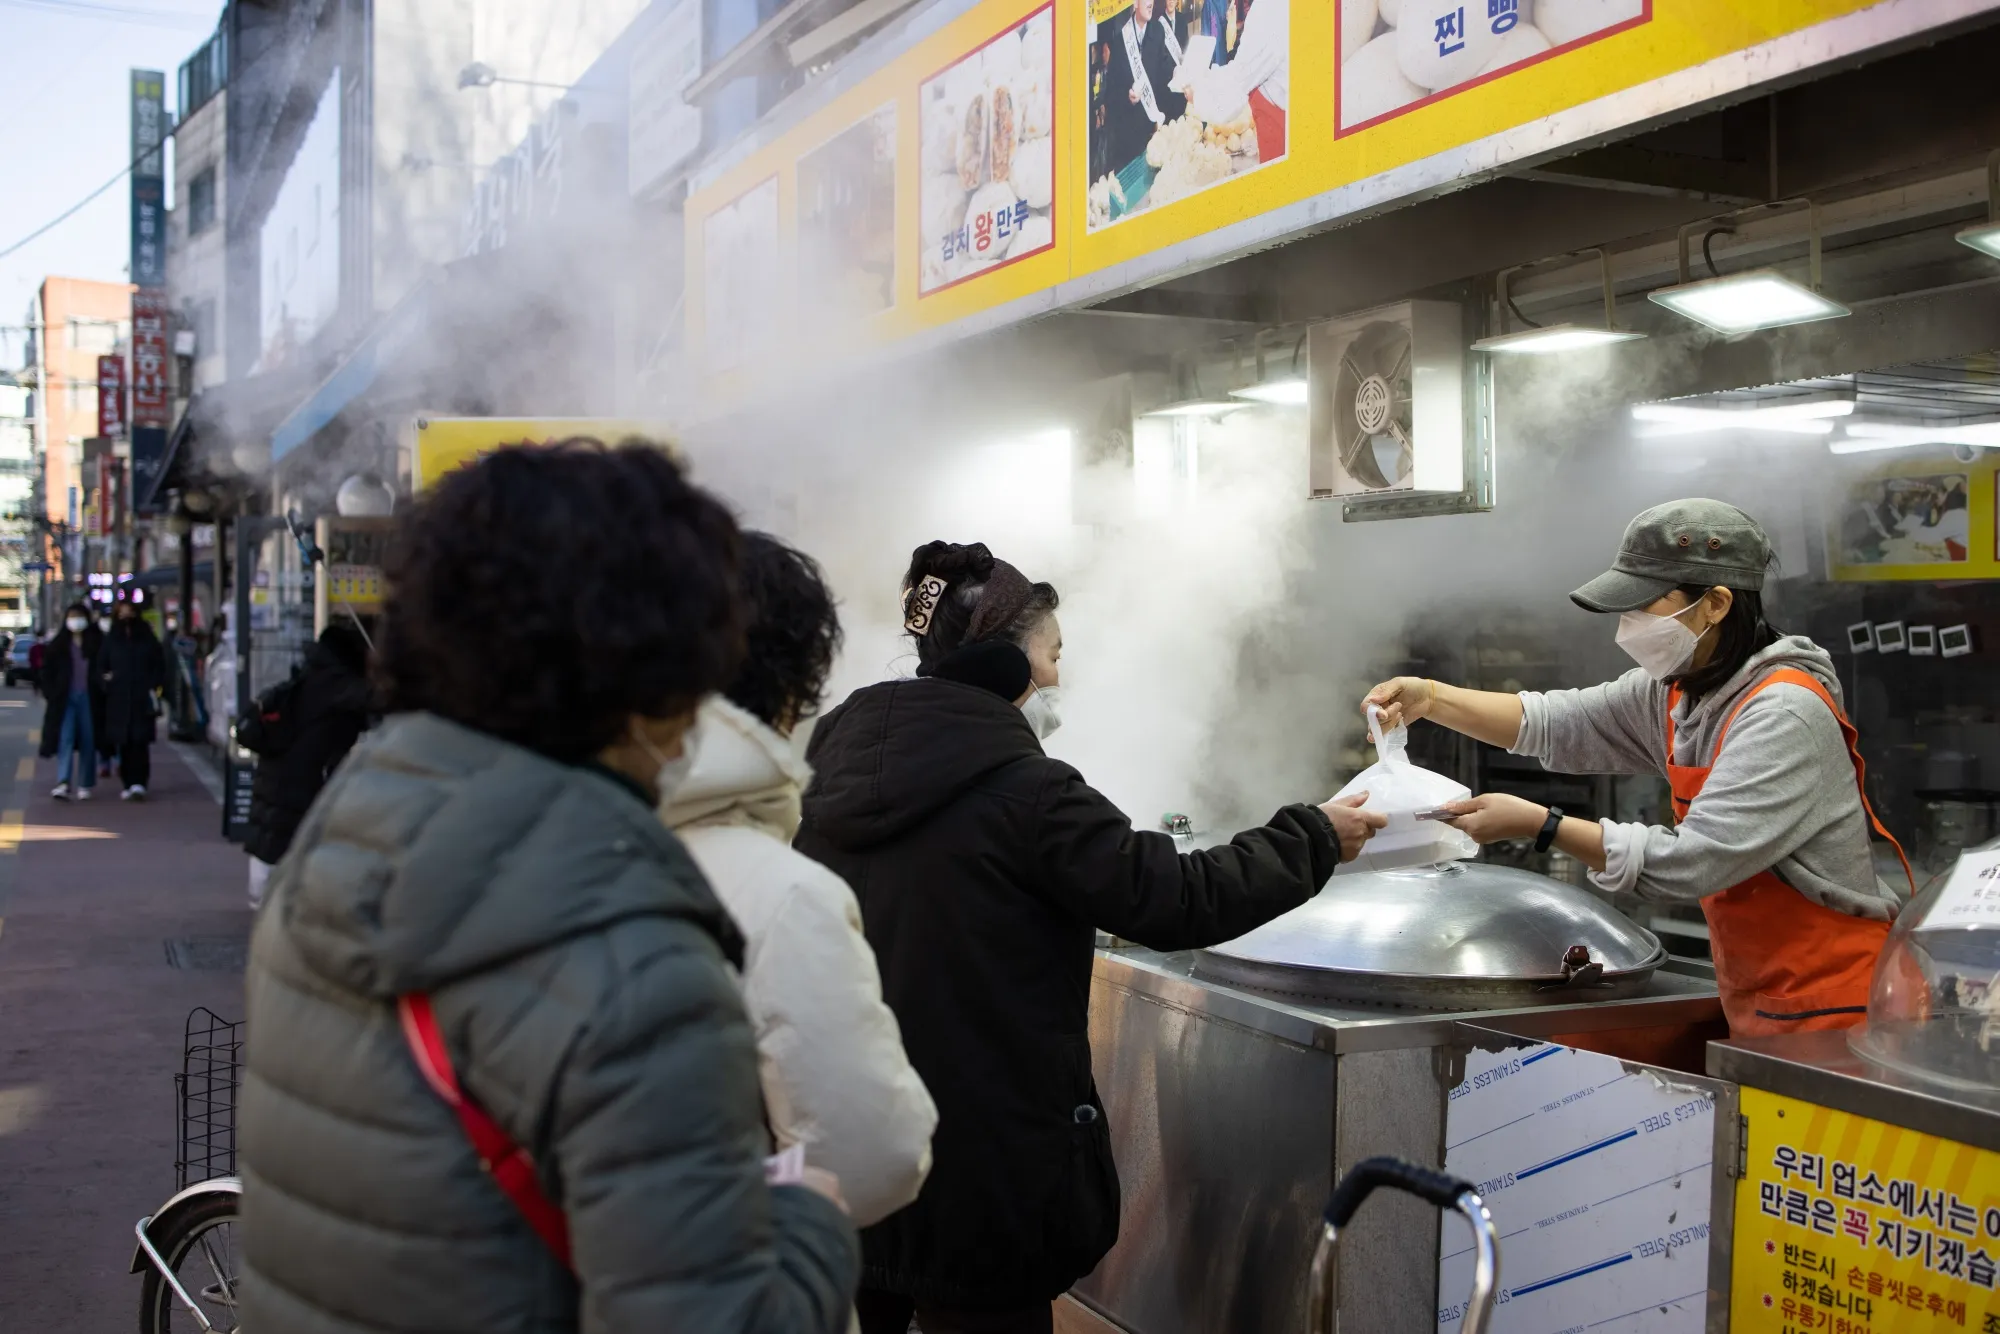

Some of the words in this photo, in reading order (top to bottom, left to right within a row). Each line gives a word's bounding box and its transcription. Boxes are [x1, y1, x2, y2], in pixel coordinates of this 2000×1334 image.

[135, 317, 163, 404] 부동산
[1473, 1058, 1520, 1090] STAINLESS
[1562, 1086, 1595, 1107] STAINLESS
[1556, 1204, 1589, 1223] STAINLESS
[1761, 1182, 1837, 1235] 만큼은
[1843, 1207, 1869, 1246] 꼭
[1774, 1147, 1824, 1189] 우리
[1832, 1162, 1977, 1236] 업소에서는
[1784, 1242, 1836, 1280] 반드시
[1782, 1270, 1873, 1322] 하겠습니다
